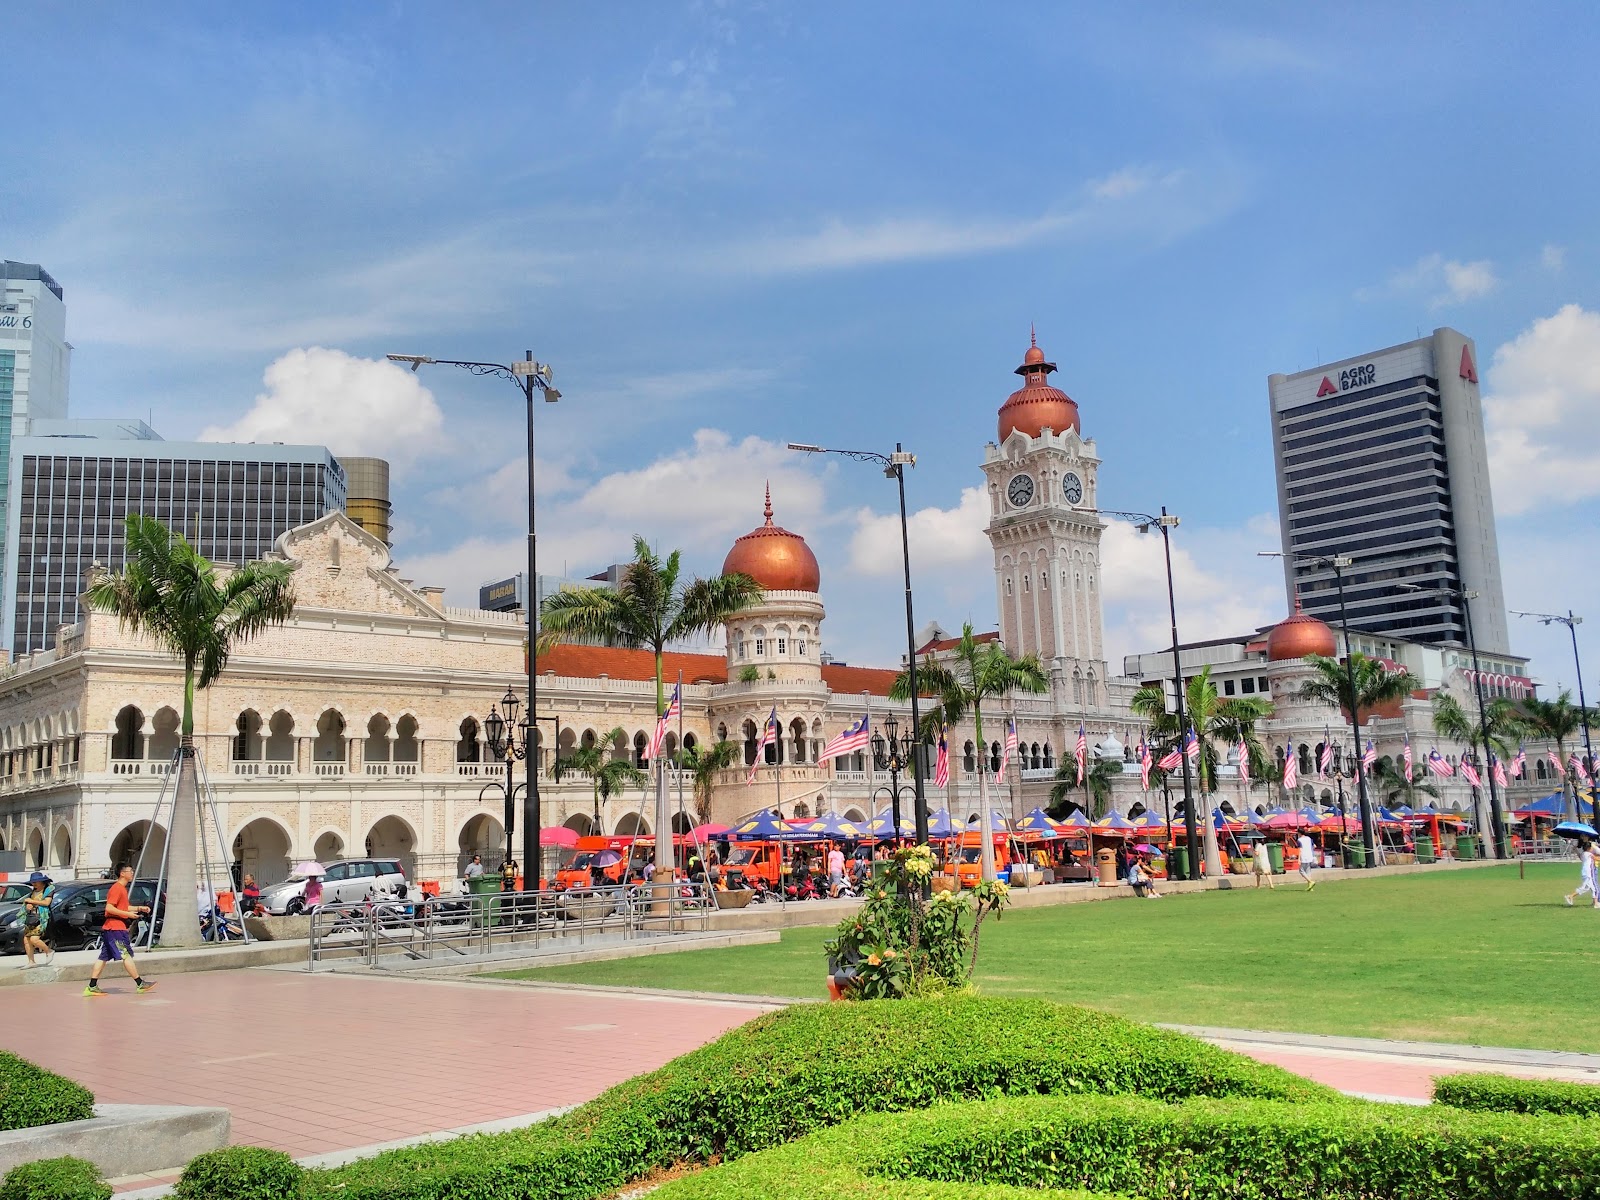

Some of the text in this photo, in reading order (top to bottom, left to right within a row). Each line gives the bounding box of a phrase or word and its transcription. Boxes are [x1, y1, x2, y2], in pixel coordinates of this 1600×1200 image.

[23, 316, 32, 328] 6
[1340, 363, 1375, 381] AGRO
[1342, 373, 1376, 391] BANK
